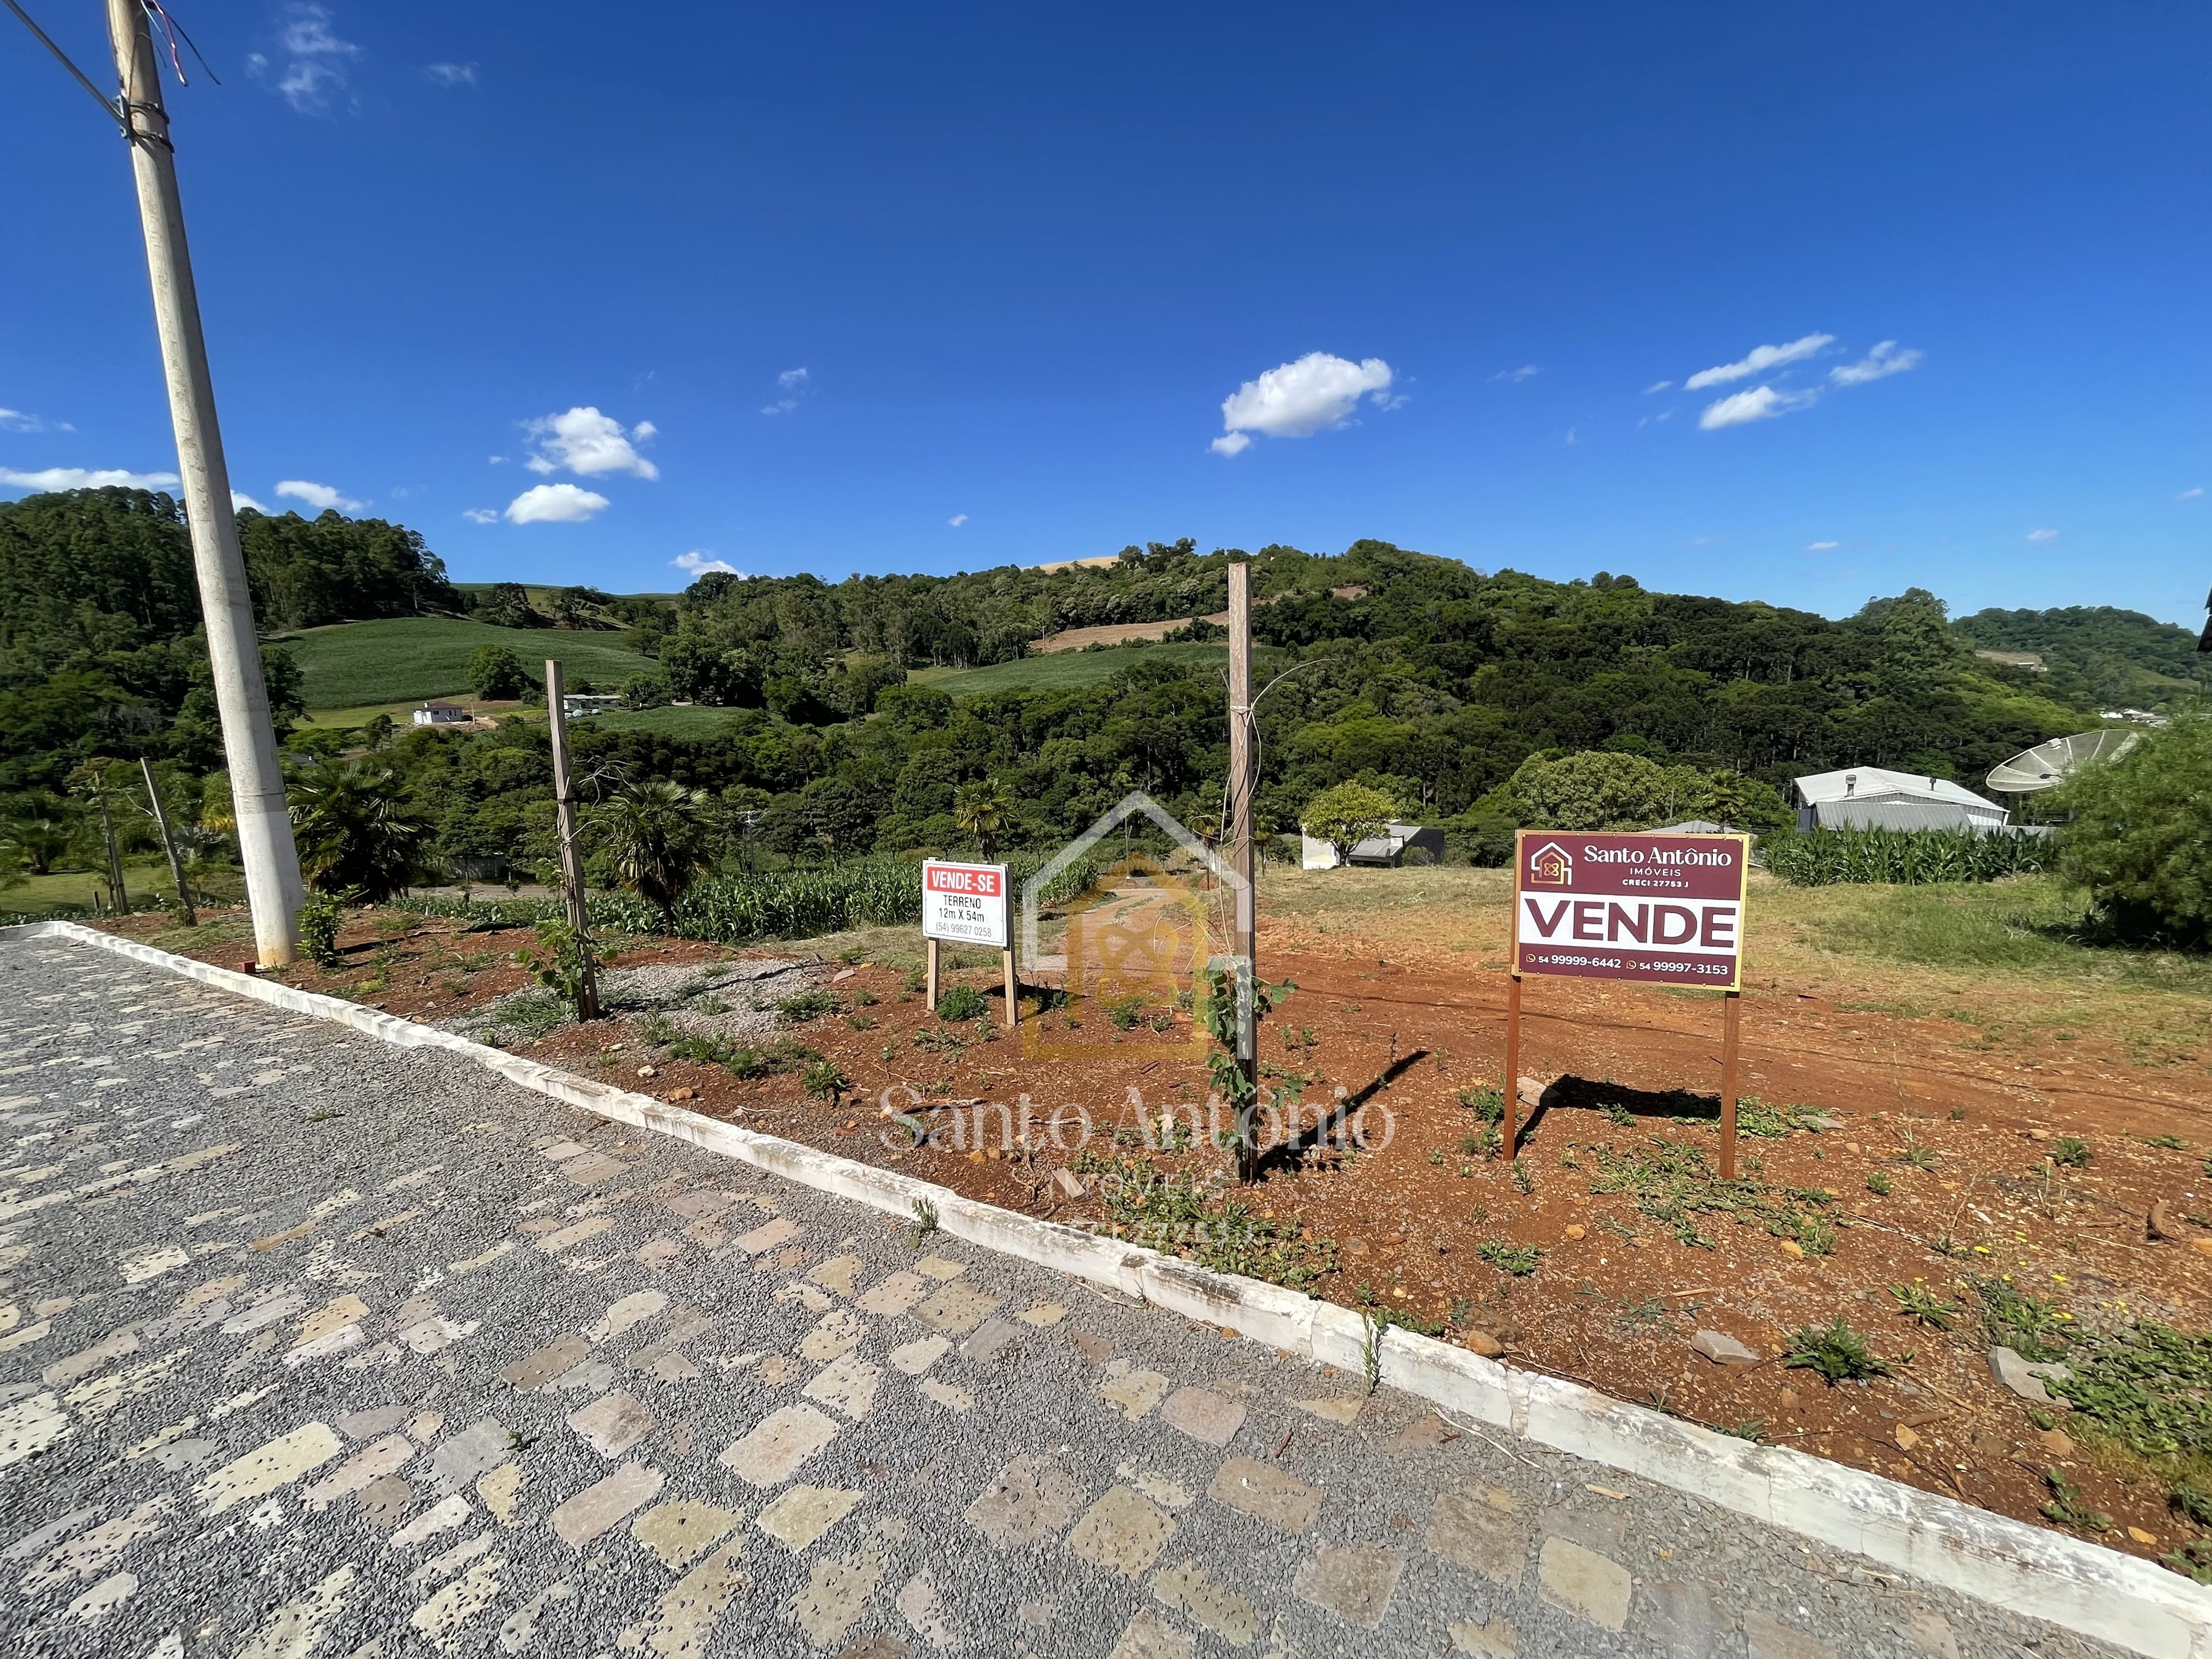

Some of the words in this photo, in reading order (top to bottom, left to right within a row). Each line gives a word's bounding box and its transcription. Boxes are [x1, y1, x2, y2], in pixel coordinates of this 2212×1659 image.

[1584, 845, 1645, 864] Santo
[1647, 847, 1733, 866] Antônio
[1630, 866, 1681, 877] IMÓVEIS
[931, 870, 995, 893] VENDE-SE
[944, 895, 981, 909] TERRENO
[939, 907, 956, 919] 12m
[958, 909, 964, 920] X
[967, 910, 984, 922] 54m
[936, 922, 949, 934] (54)
[951, 923, 972, 934] 99627
[974, 926, 991, 937] 0258
[1525, 898, 1736, 948] VENDE
[1551, 955, 1621, 968] 99999-6442
[1639, 962, 1651, 970] 54
[1653, 961, 1728, 975] 99997-3153
